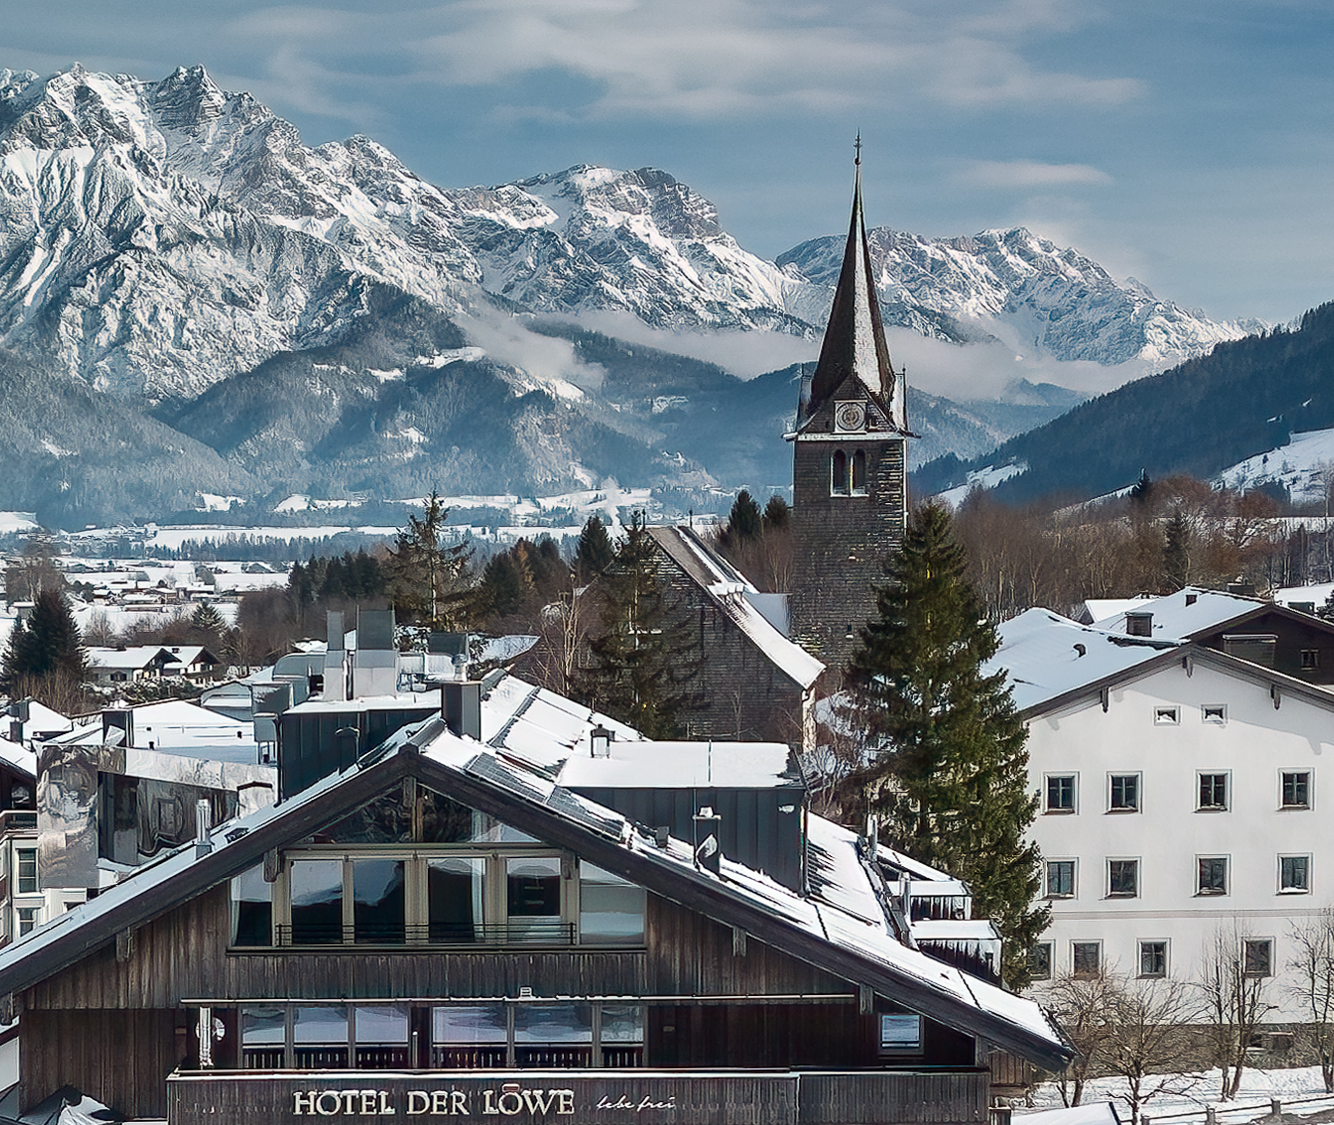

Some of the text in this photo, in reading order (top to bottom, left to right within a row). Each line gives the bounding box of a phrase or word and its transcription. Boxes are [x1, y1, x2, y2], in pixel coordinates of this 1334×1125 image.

[293, 1083, 575, 1115] HOTEL DER LÖWE
[596, 1095, 676, 1111] lebe frei
